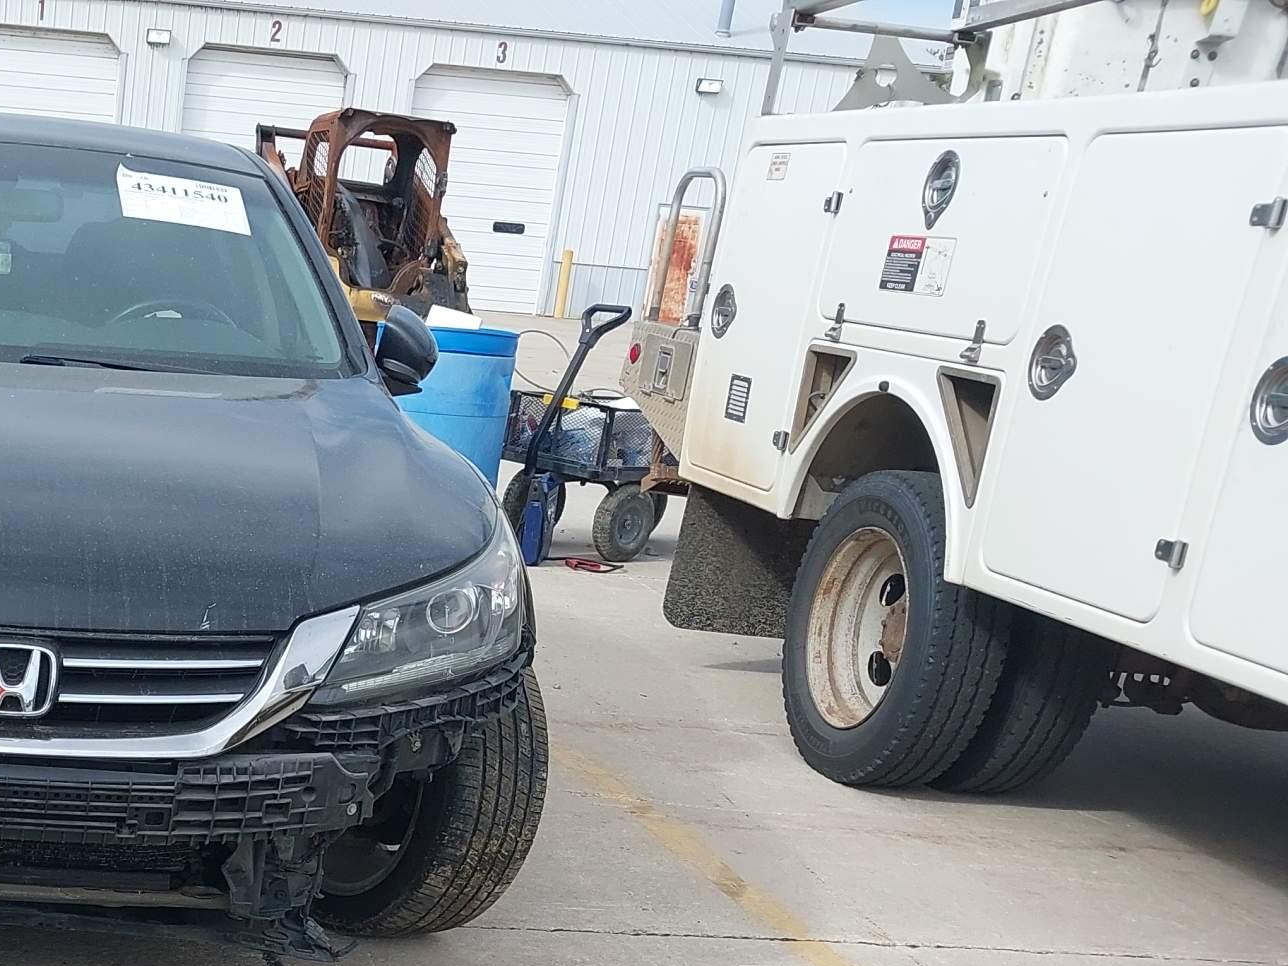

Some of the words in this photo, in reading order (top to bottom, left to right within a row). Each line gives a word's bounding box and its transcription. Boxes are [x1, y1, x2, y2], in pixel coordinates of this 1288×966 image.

[38, 0, 45, 21] 1
[270, 20, 282, 43] 2
[496, 41, 508, 63] 3
[131, 182, 228, 203] 43411540
[899, 239, 923, 250] DANGER
